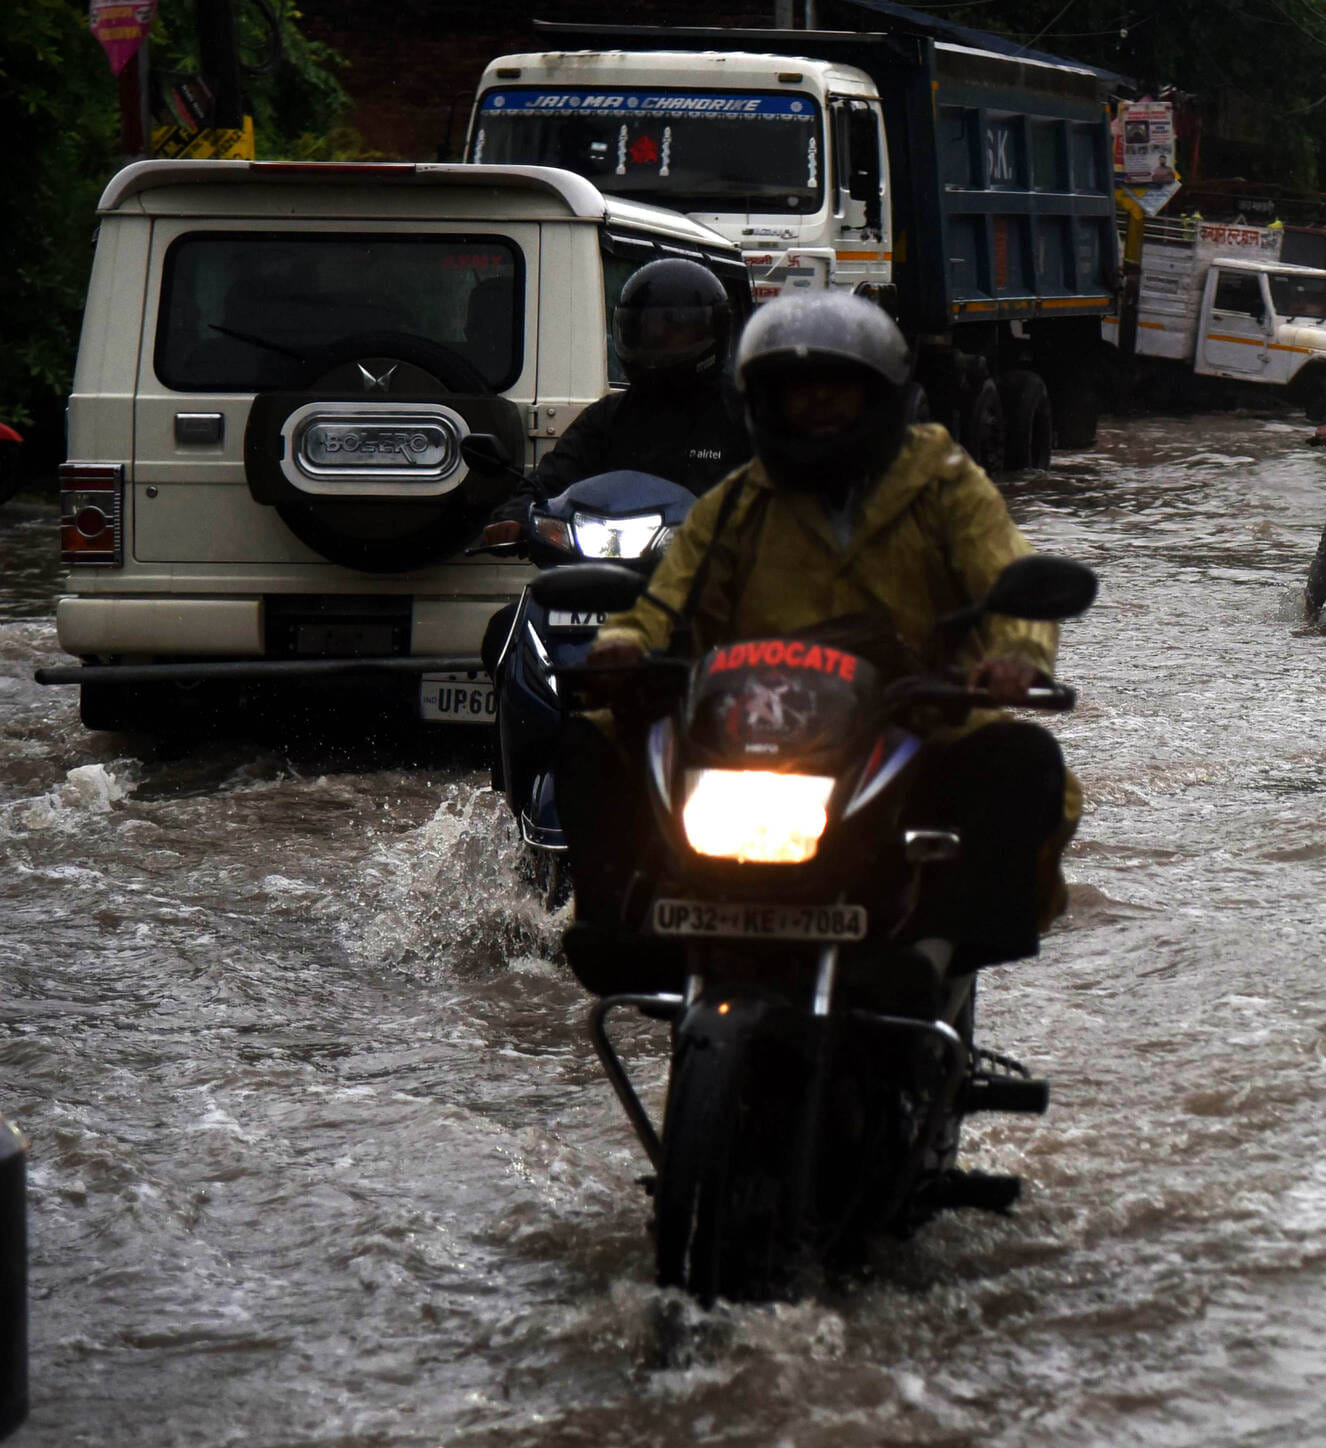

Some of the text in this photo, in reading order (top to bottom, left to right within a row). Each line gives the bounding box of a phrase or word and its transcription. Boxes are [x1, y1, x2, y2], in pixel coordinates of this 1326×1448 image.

[524, 95, 763, 111] JAI MA CHANDRIKE
[325, 432, 429, 464] BOLERO
[708, 639, 859, 683] ADVOCATE
